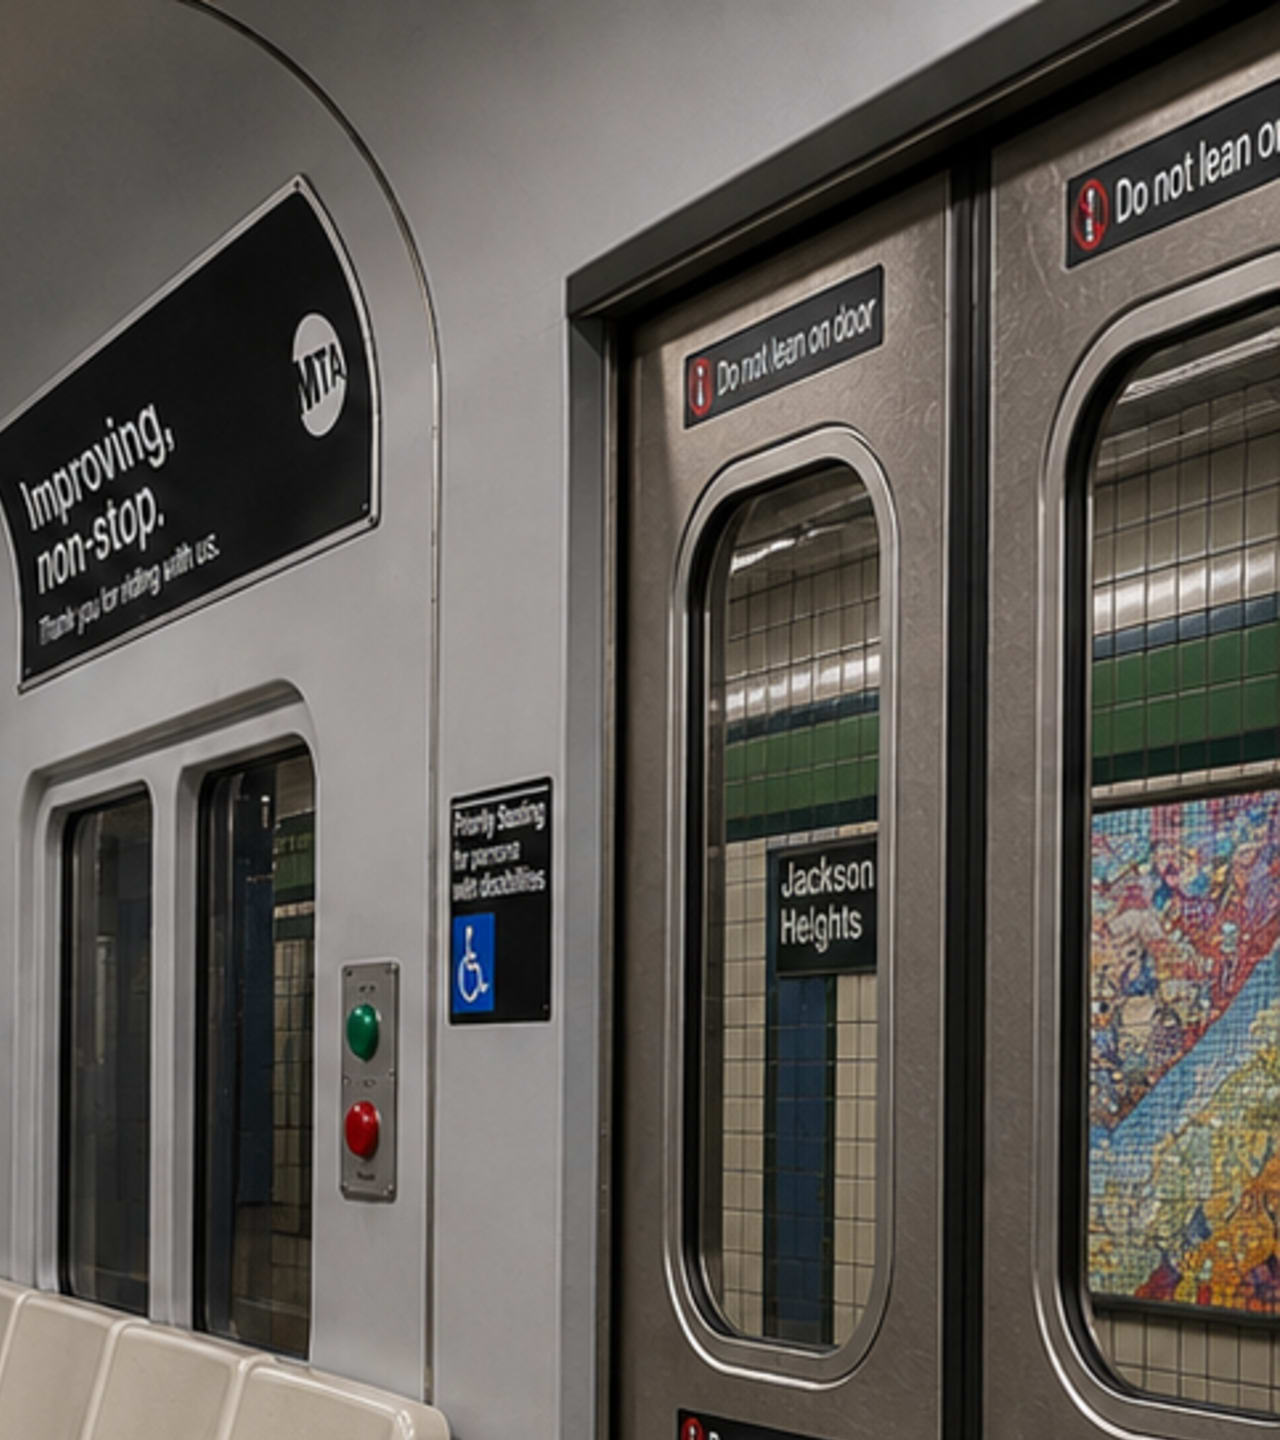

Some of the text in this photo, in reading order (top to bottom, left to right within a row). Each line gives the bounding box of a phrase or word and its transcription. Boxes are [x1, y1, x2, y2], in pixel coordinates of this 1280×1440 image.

[1116, 119, 1280, 224] Do not lean o
[717, 359, 740, 396] Do
[808, 319, 830, 354] on
[833, 298, 876, 342] door
[20, 403, 175, 531] Improving,
[38, 487, 164, 594] non-stop.
[781, 855, 874, 898] Jackson
[781, 903, 862, 953] Heights
